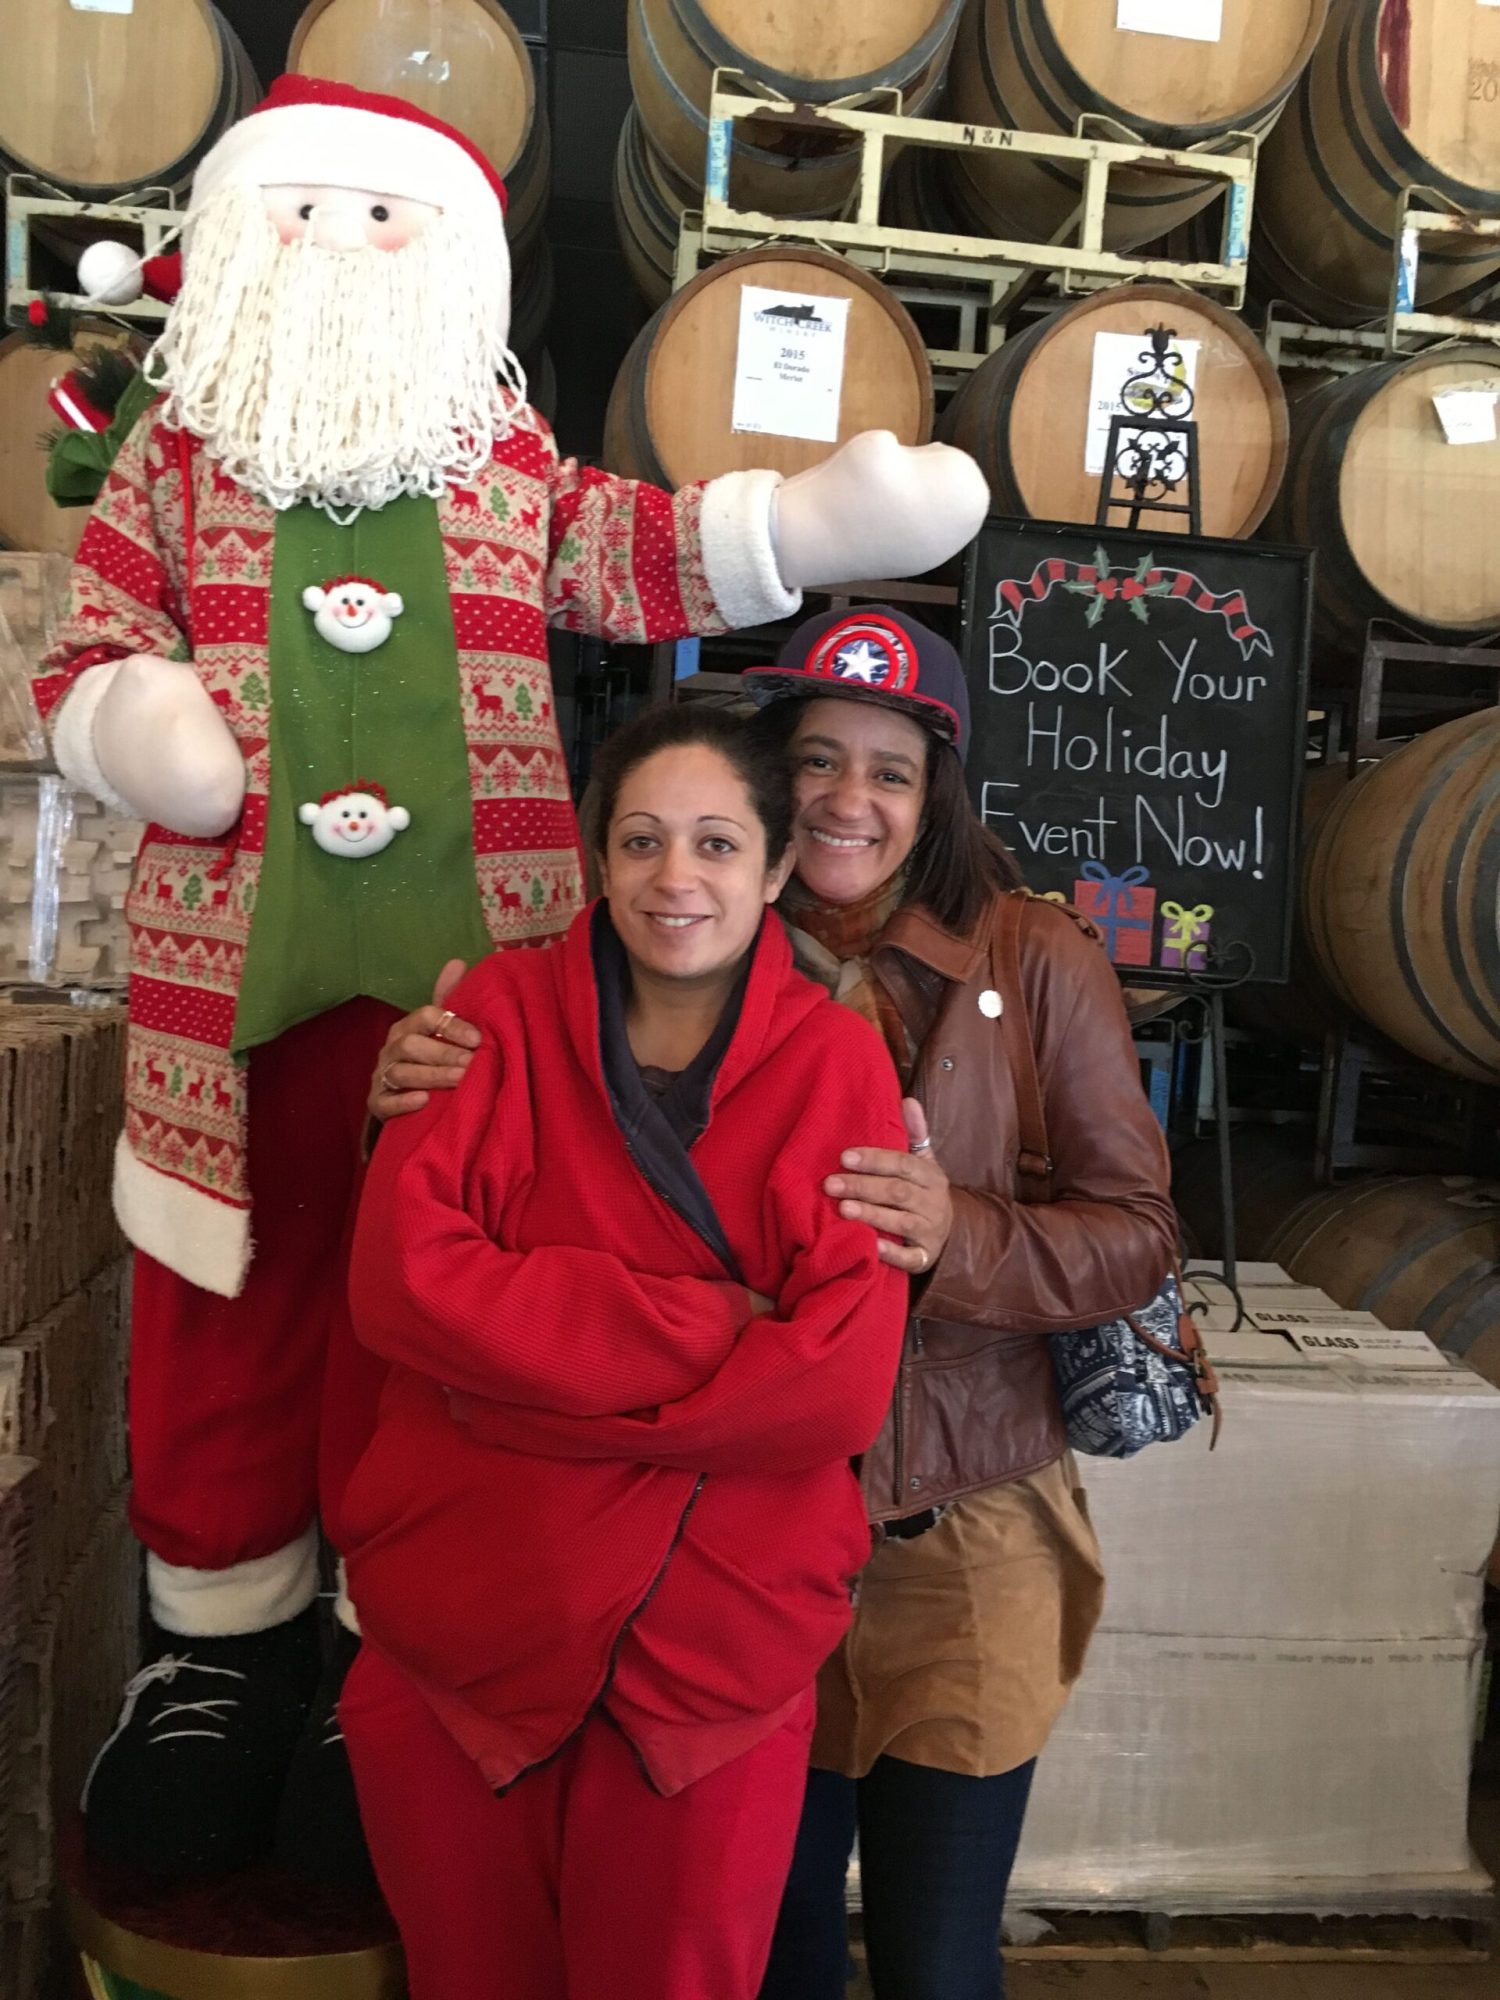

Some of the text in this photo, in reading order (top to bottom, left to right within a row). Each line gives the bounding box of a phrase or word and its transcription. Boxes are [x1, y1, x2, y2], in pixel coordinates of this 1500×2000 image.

[963, 126, 1013, 147] N & N
[780, 348, 806, 360] 2015
[1097, 400, 1122, 411] 2015
[1157, 638, 1267, 704] Your
[1027, 701, 1227, 808] Holiday
[981, 781, 1264, 880] Event Now!
[1255, 1312, 1310, 1323] GLASS
[1301, 1335, 1360, 1349] GLASS
